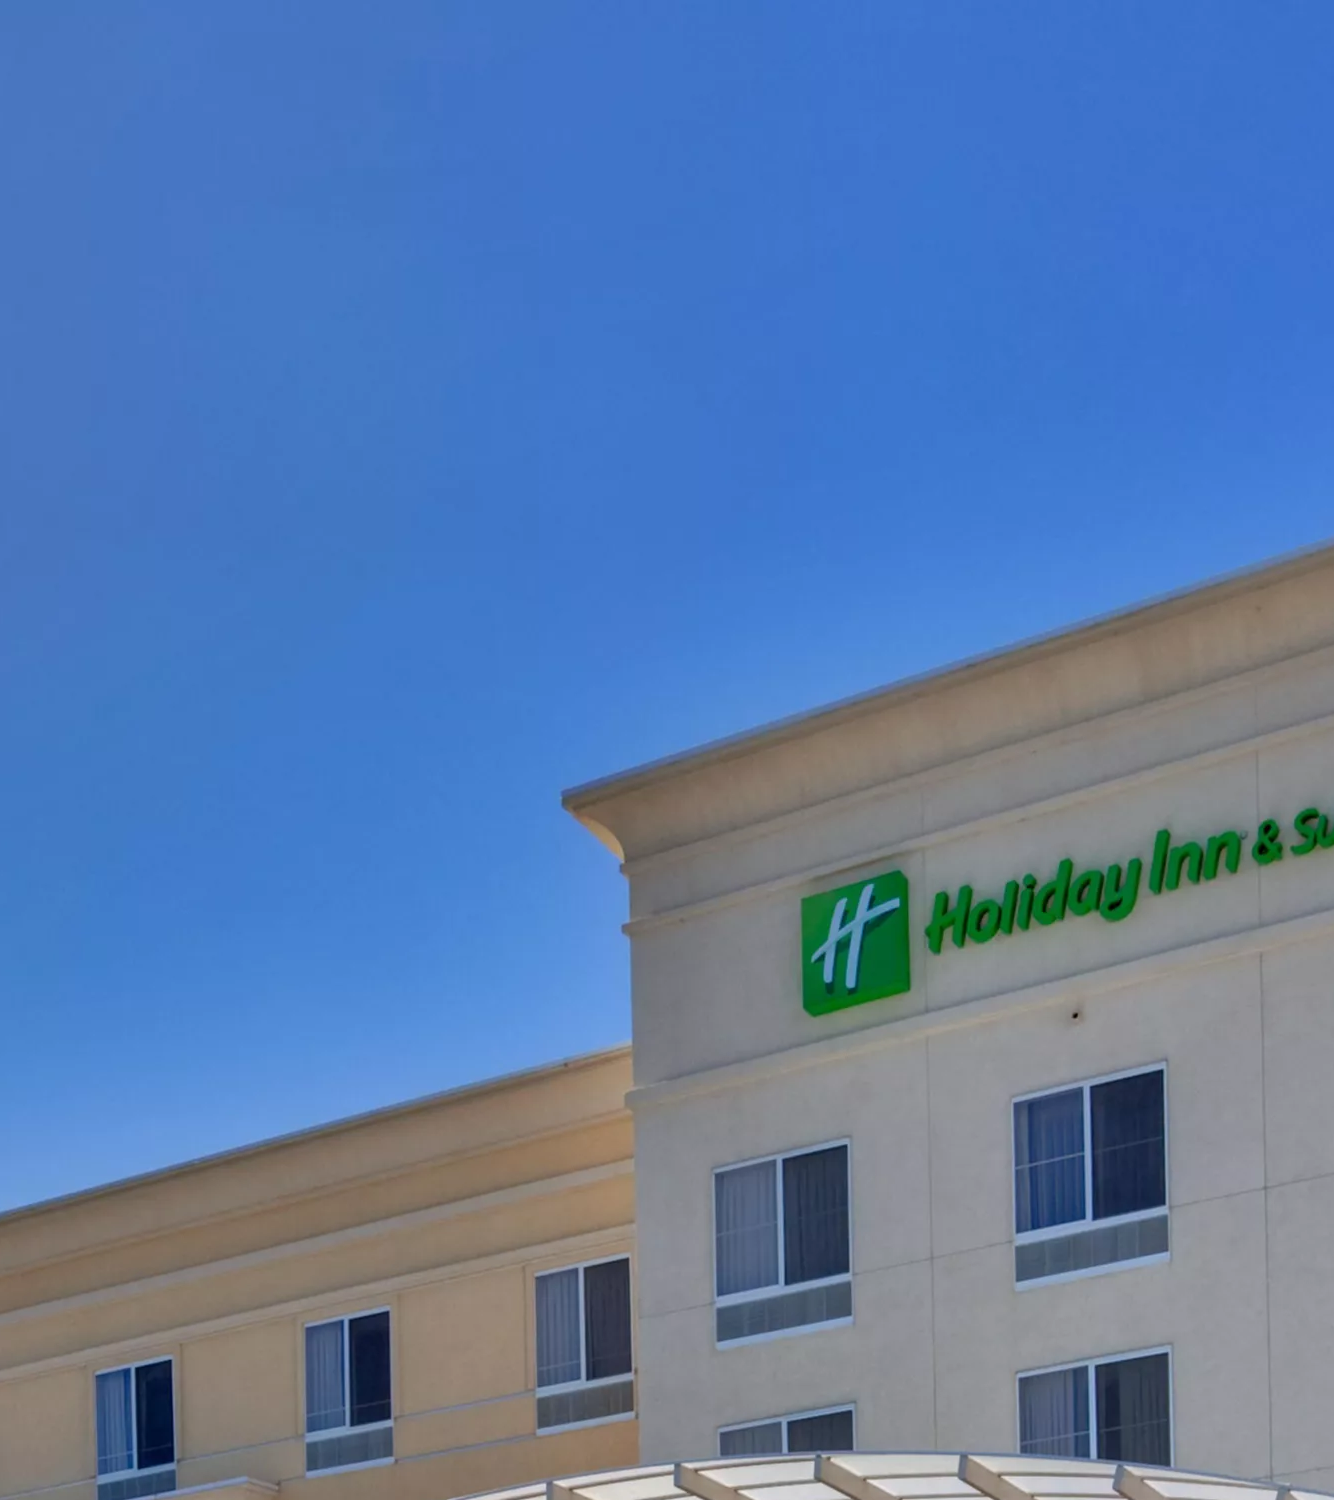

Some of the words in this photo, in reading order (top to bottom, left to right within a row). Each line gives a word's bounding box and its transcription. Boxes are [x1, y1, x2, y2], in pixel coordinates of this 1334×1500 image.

[925, 858, 1142, 955] Holiday
[1149, 829, 1241, 894] Inn
[1252, 819, 1283, 865] &
